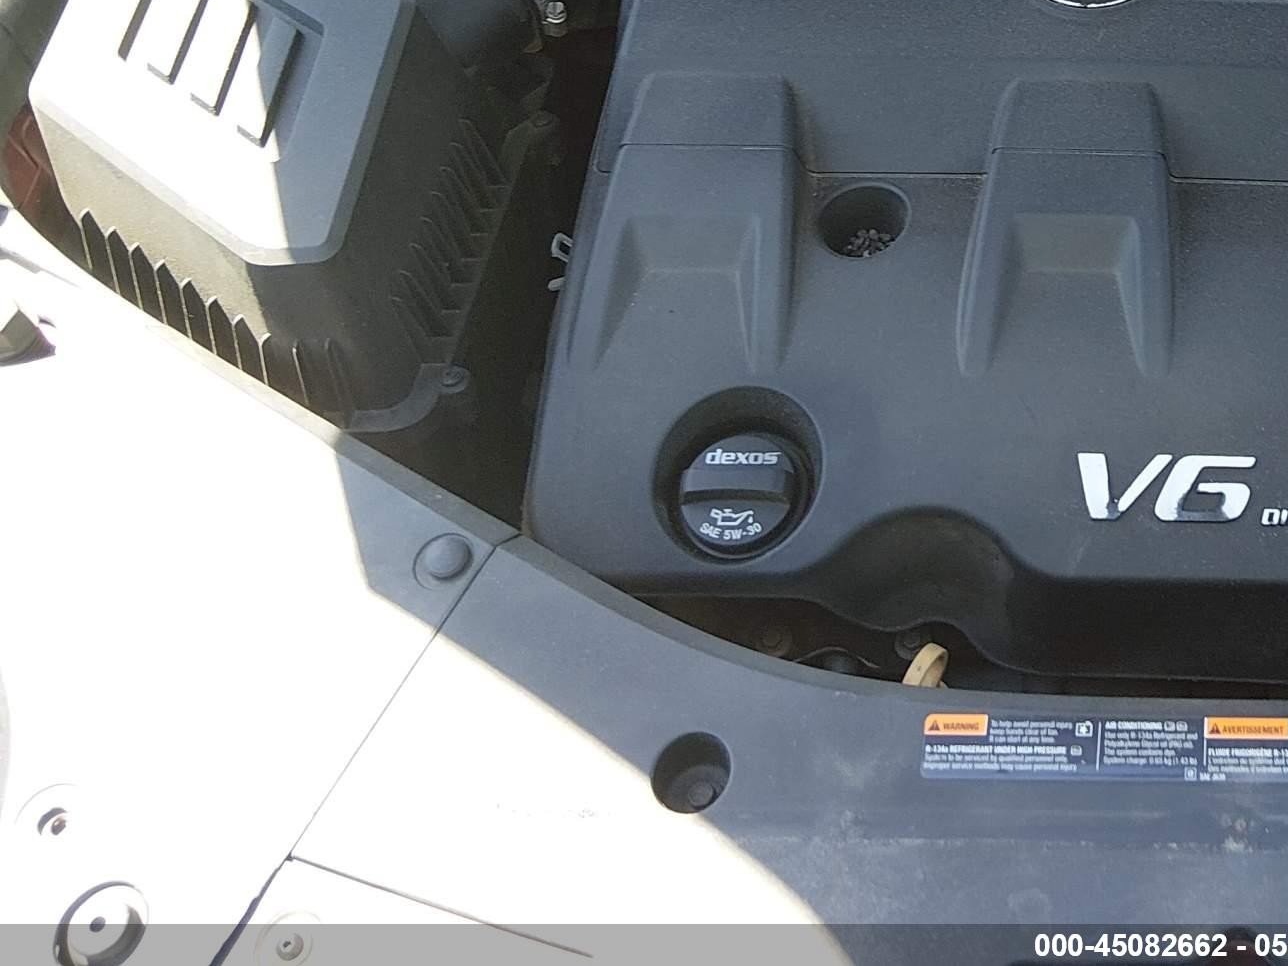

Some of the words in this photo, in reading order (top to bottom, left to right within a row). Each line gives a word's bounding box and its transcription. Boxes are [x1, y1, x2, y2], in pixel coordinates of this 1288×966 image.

[705, 448, 782, 464] dexos
[1077, 451, 1256, 522] V6
[699, 523, 722, 538] SAE
[723, 523, 762, 540] 5W-30
[943, 722, 979, 730] WARNING
[1118, 721, 1162, 730] CONDITIONING
[1222, 725, 1284, 734] AVERTISSEMENT
[950, 745, 993, 754] REFRIGERANT
[994, 745, 1016, 754] UNDER
[1034, 745, 1066, 754] PRESSURE
